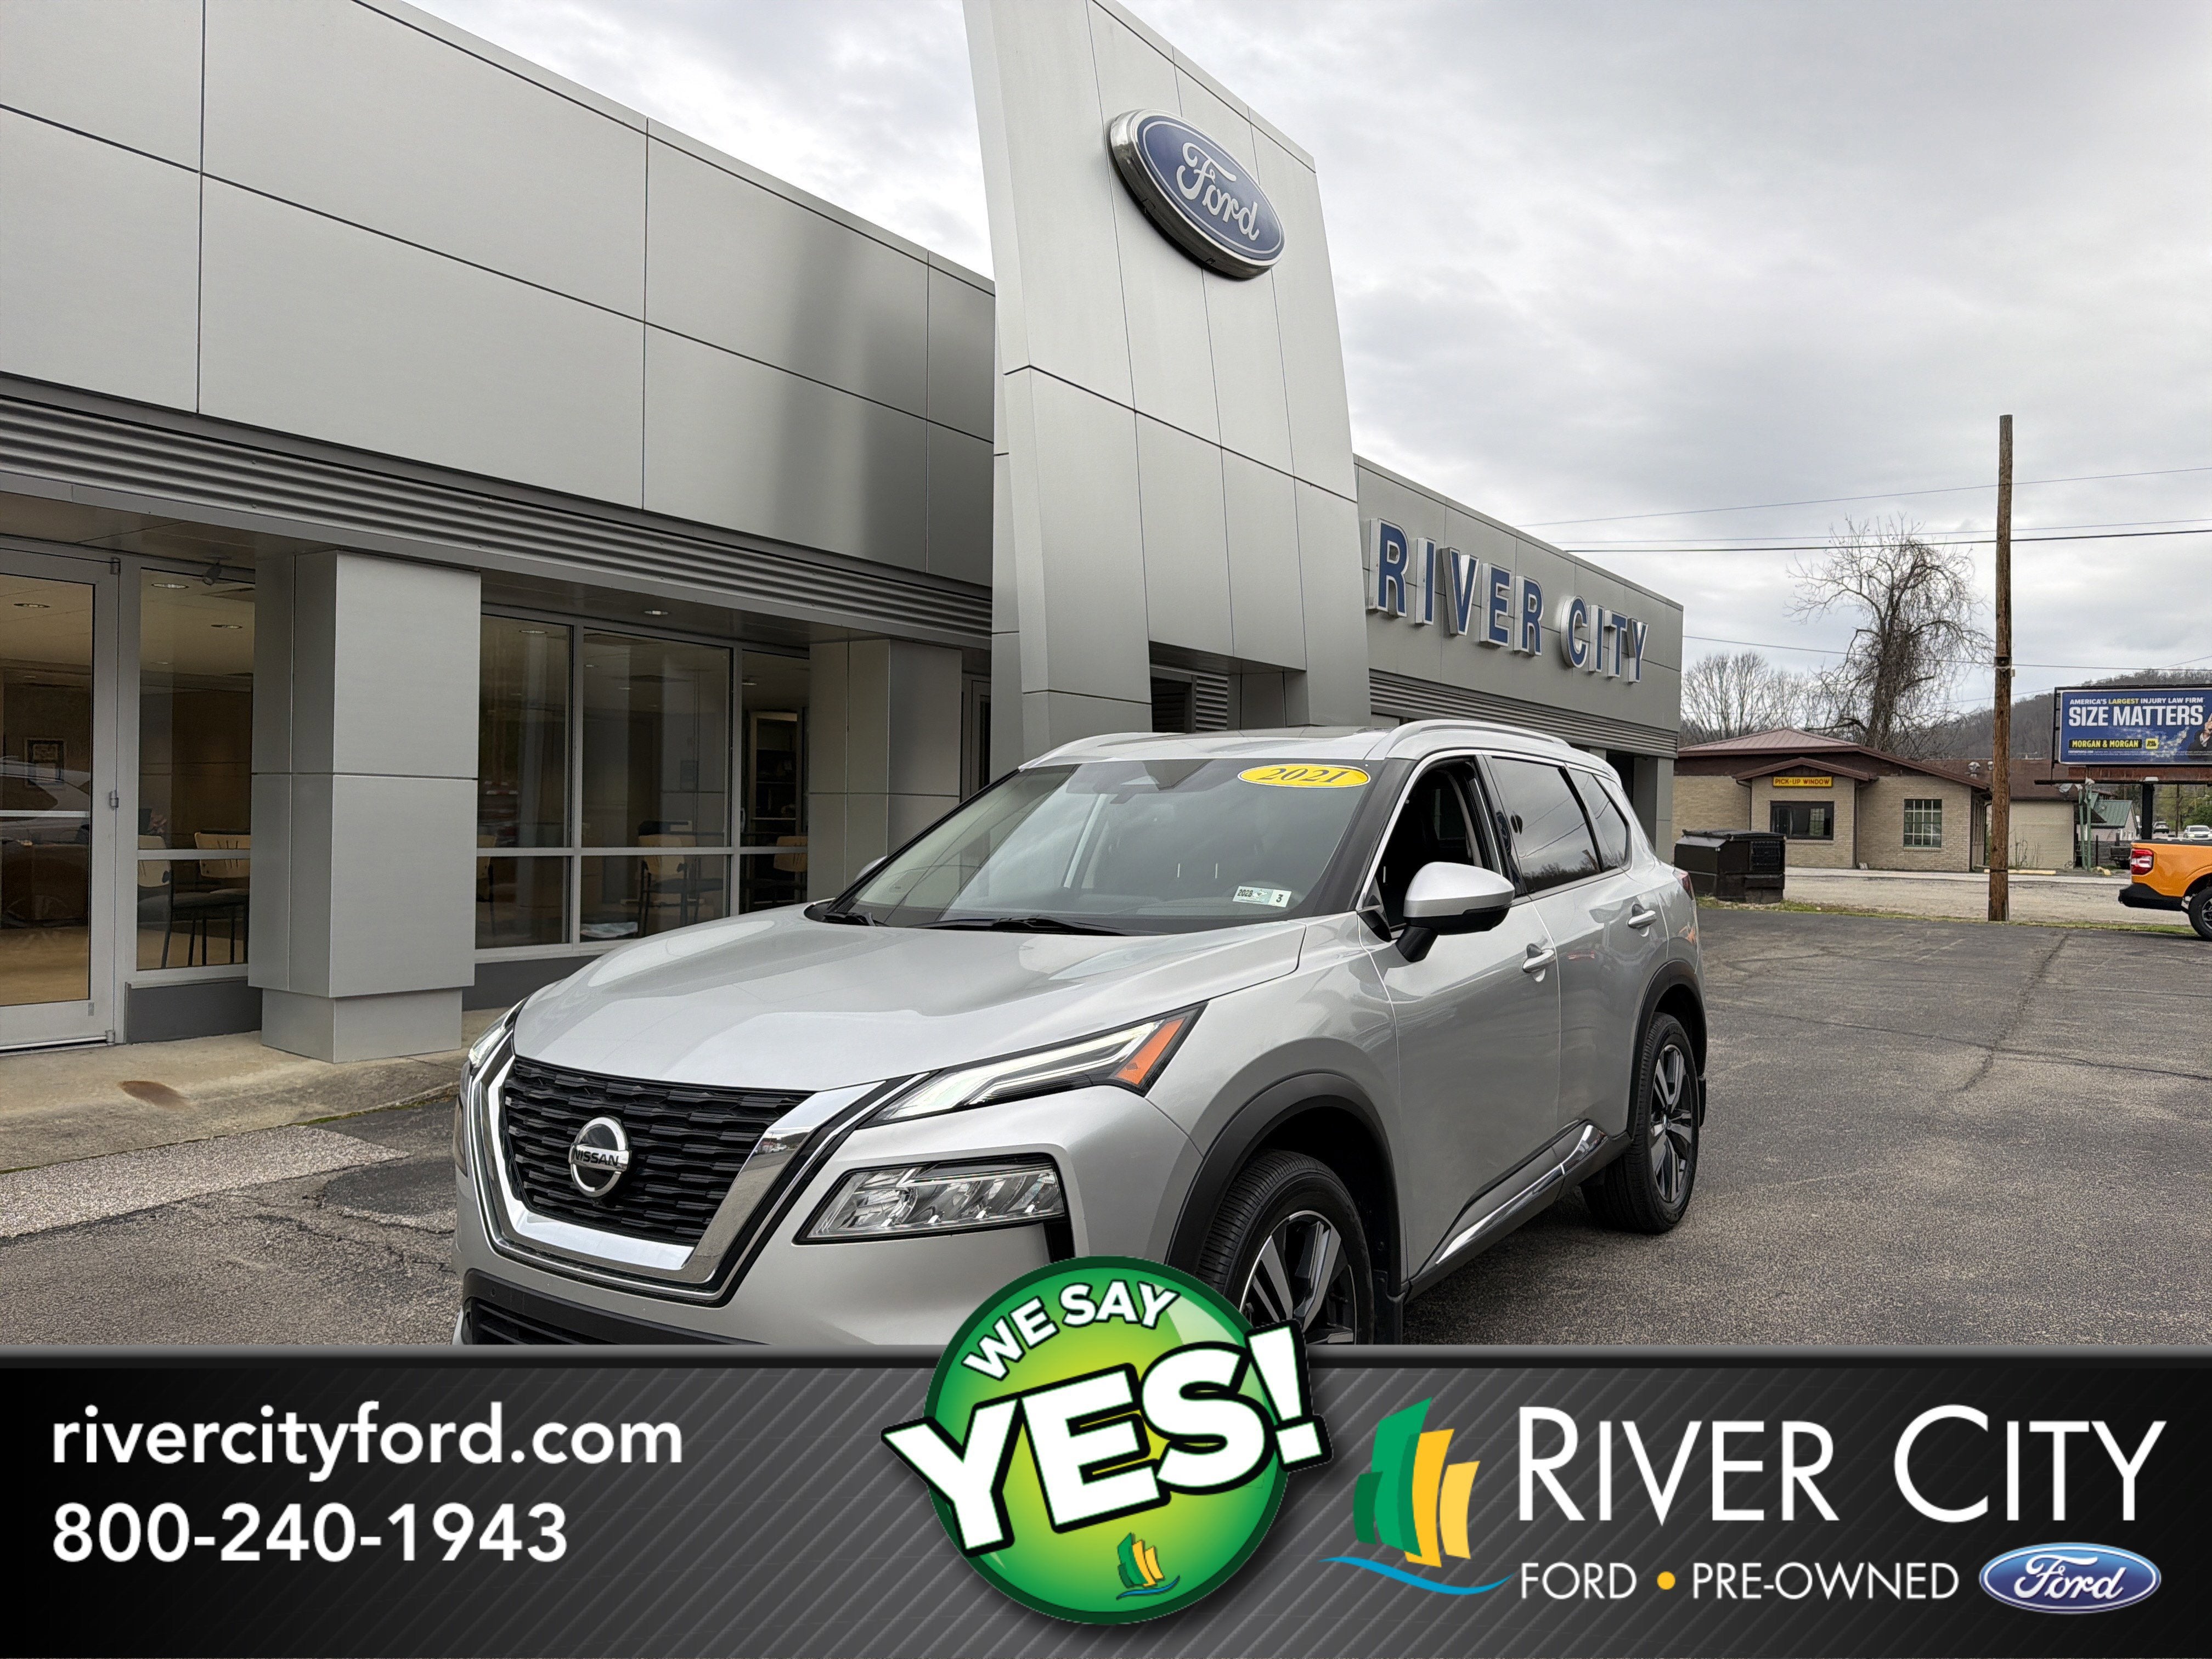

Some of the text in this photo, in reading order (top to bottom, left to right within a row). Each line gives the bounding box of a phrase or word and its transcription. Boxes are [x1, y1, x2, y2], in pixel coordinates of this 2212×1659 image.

[1176, 142, 1260, 241] Ford
[1368, 517, 1649, 683] RIVER CITY
[2069, 705, 2203, 726] SIZE MATTERS
[2109, 740, 2138, 748] MORGAN
[1256, 768, 1351, 783] 2021
[1276, 894, 1284, 902] 3
[573, 1149, 619, 1166] NISSAN
